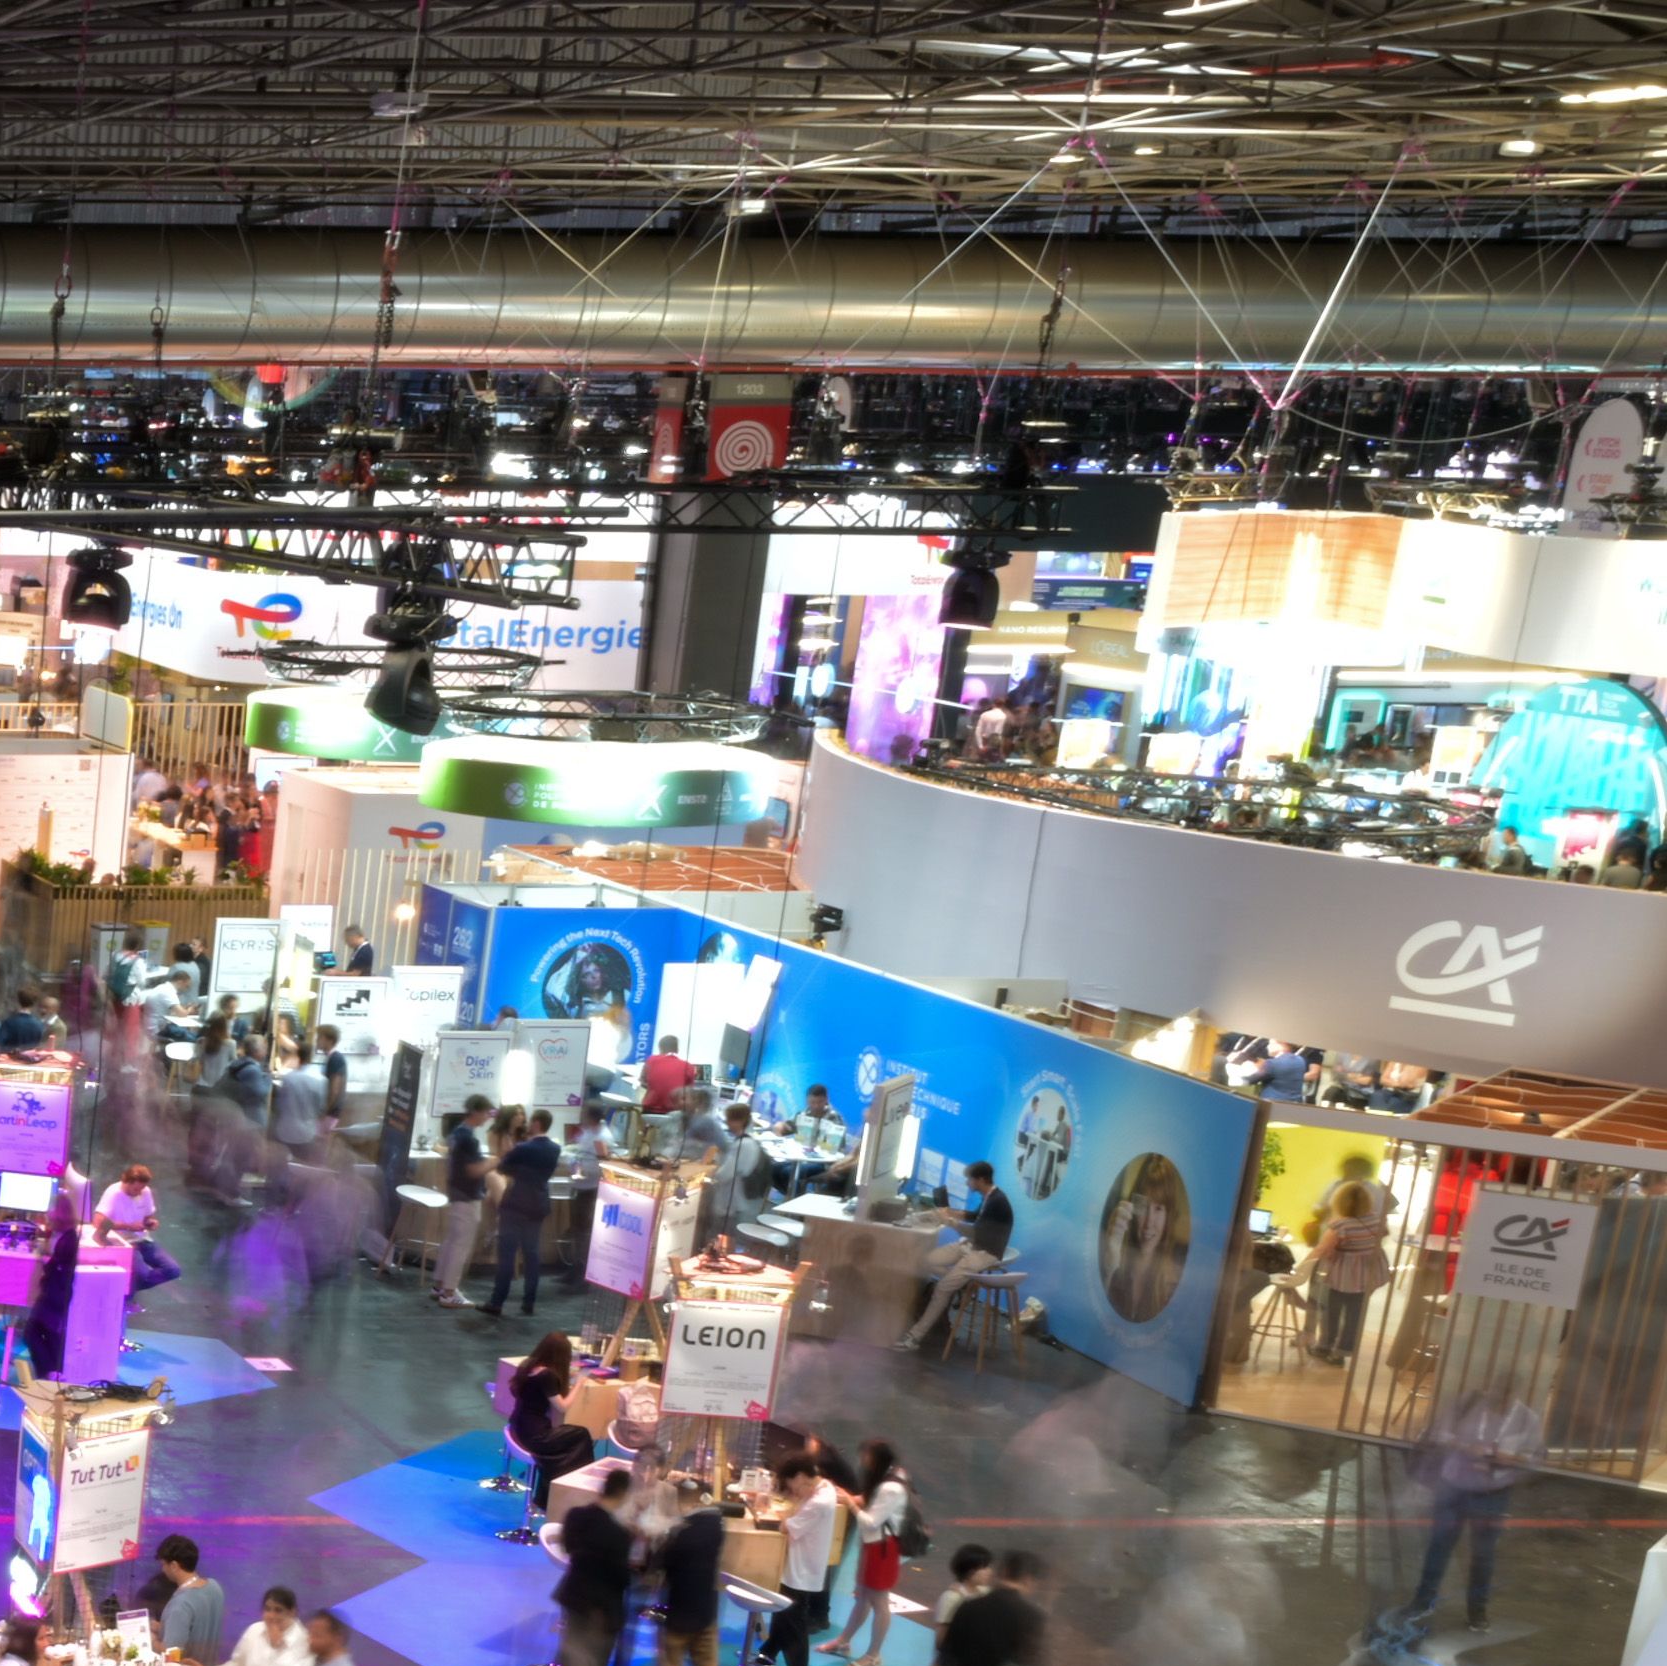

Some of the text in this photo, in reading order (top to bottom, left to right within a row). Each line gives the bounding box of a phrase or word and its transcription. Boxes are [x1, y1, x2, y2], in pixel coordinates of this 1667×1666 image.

[736, 383, 765, 395] 1203
[436, 620, 645, 659] otalEnergie
[531, 926, 648, 1004] Powering the Next Tech Revolution
[912, 1086, 962, 1116] ECHNIQUE
[1482, 1273, 1552, 1293] FRANCE
[1494, 1262, 1545, 1279] ILE DE
[681, 1323, 767, 1350] LEION
[70, 1461, 124, 1487] Tut Tut
